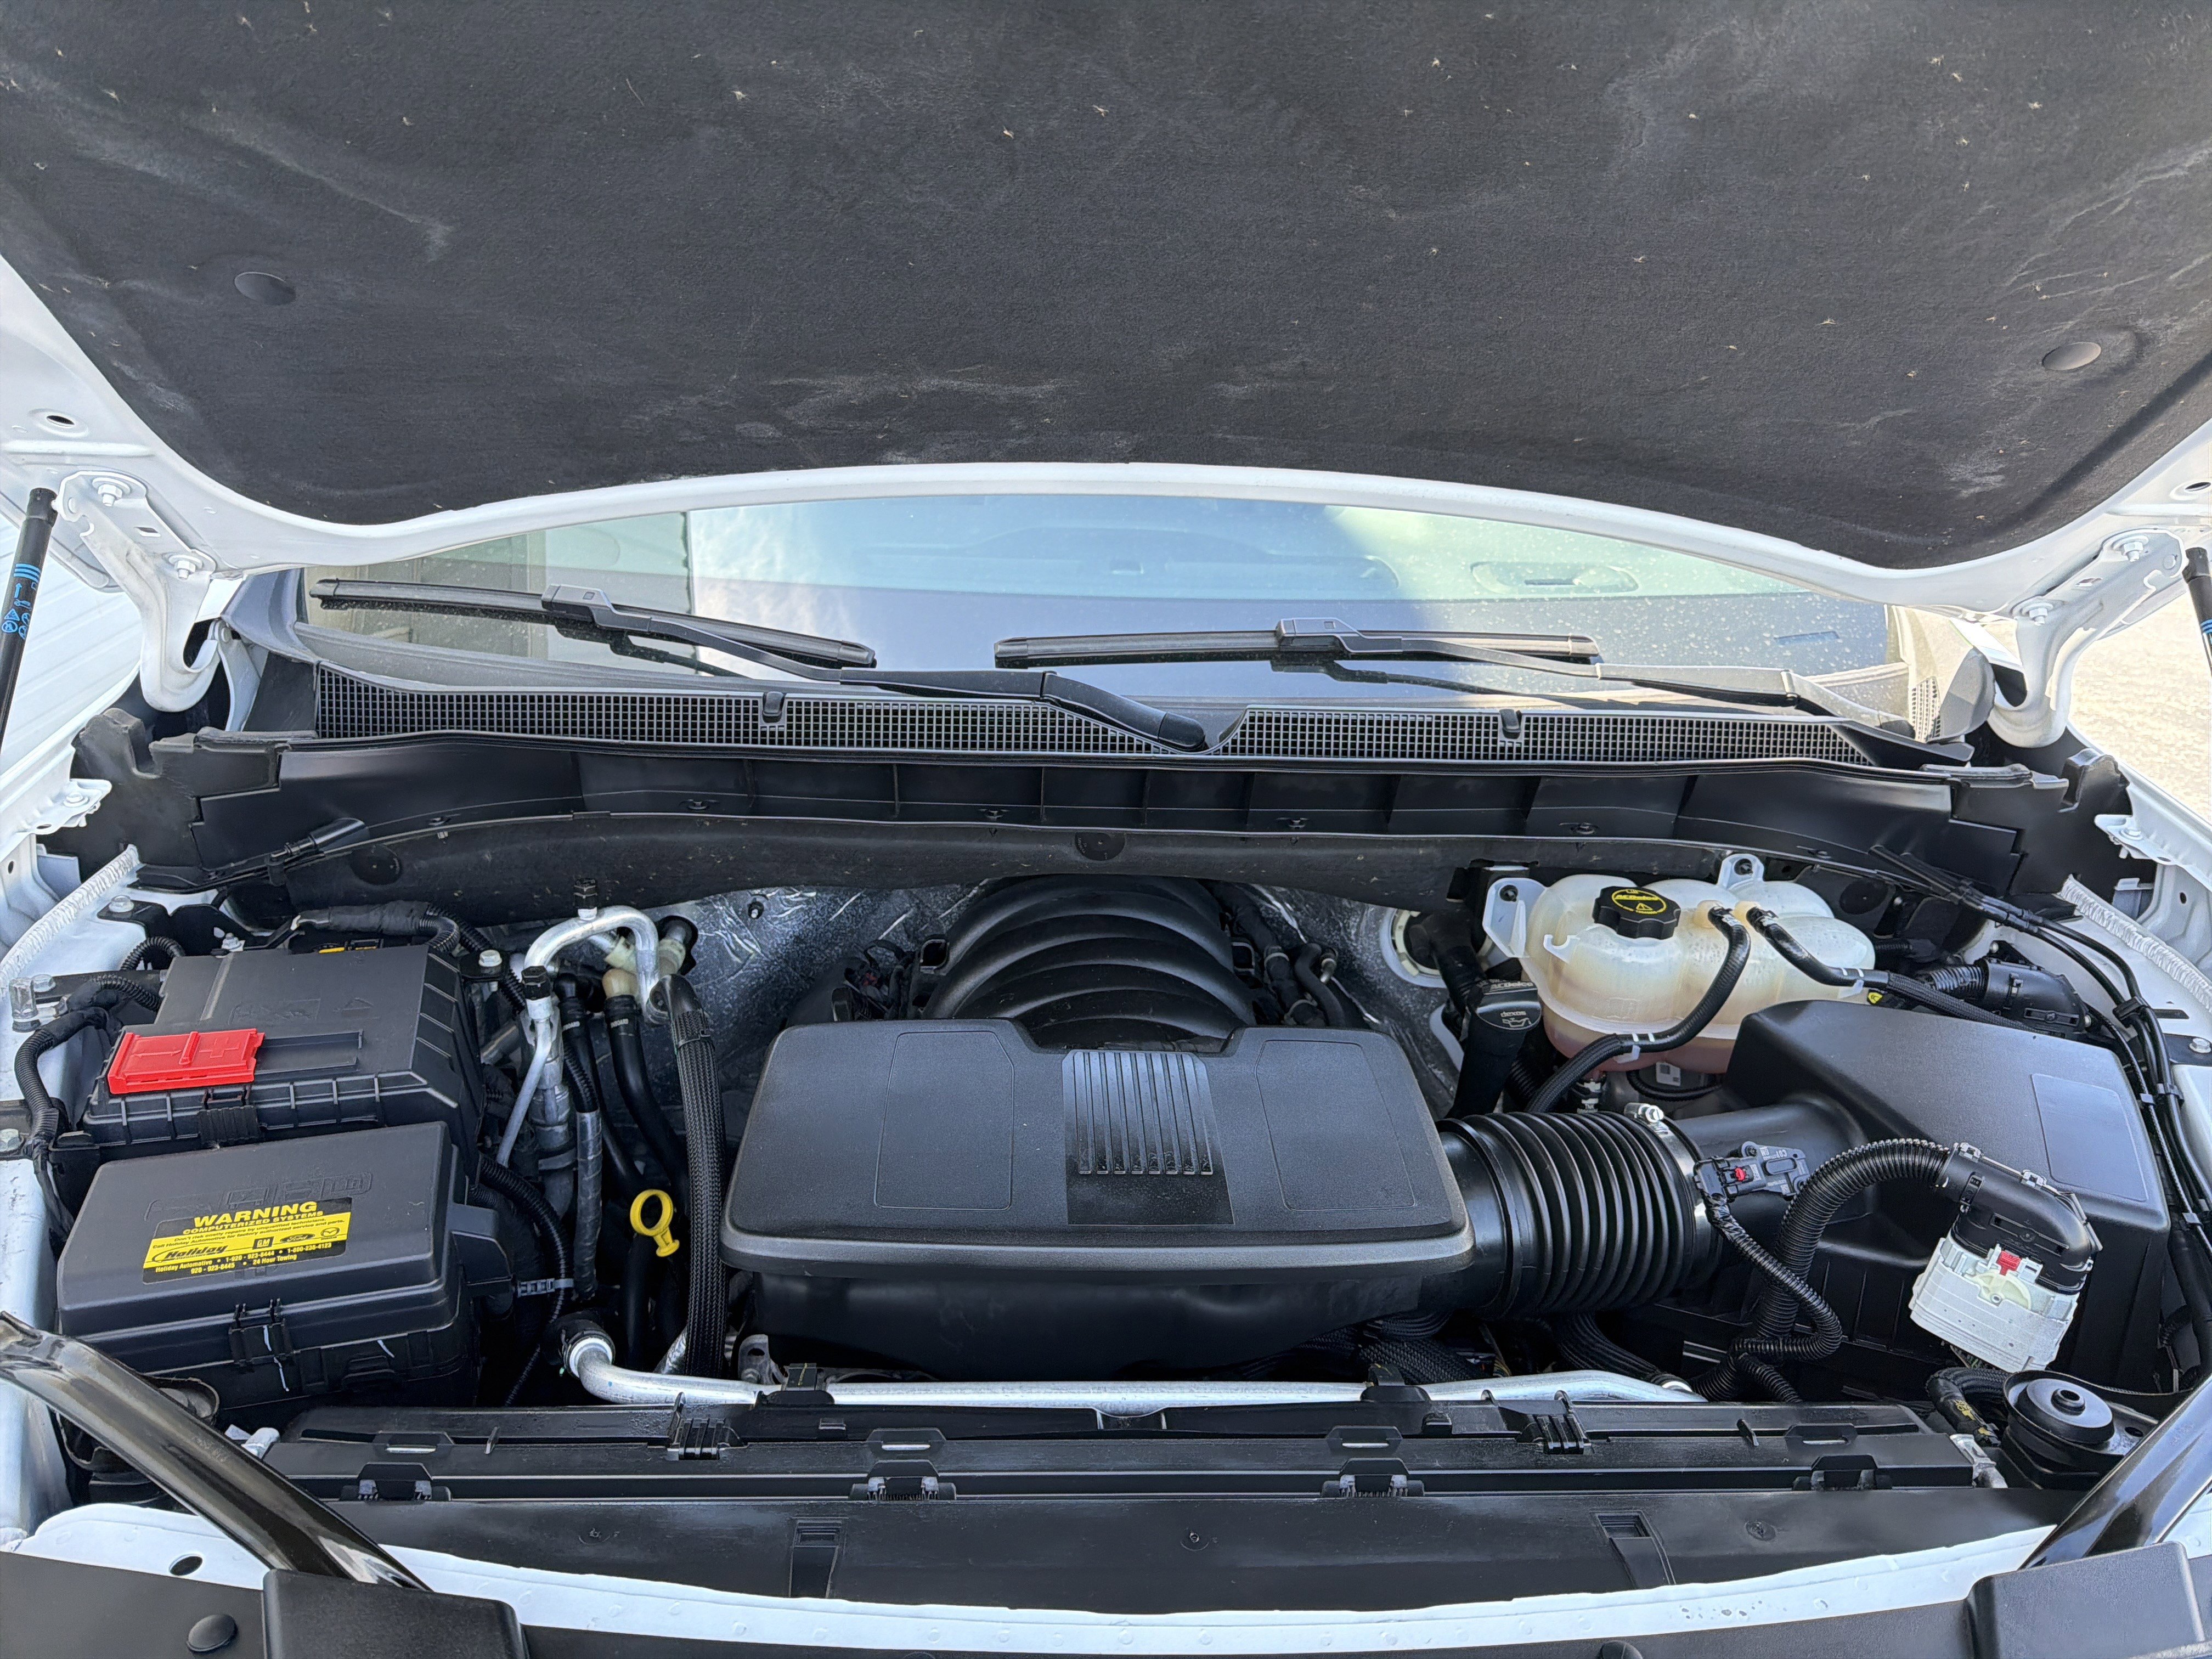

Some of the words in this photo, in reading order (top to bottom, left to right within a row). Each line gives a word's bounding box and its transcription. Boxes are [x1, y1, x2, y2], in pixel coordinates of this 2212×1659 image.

[194, 1201, 317, 1227] WARNING
[183, 1219, 270, 1234] COMPUTERIZED
[273, 1211, 323, 1222] SYSTEMS
[257, 1239, 270, 1248] GM
[165, 1245, 228, 1259] Holiday
[179, 1260, 213, 1269] Automotive
